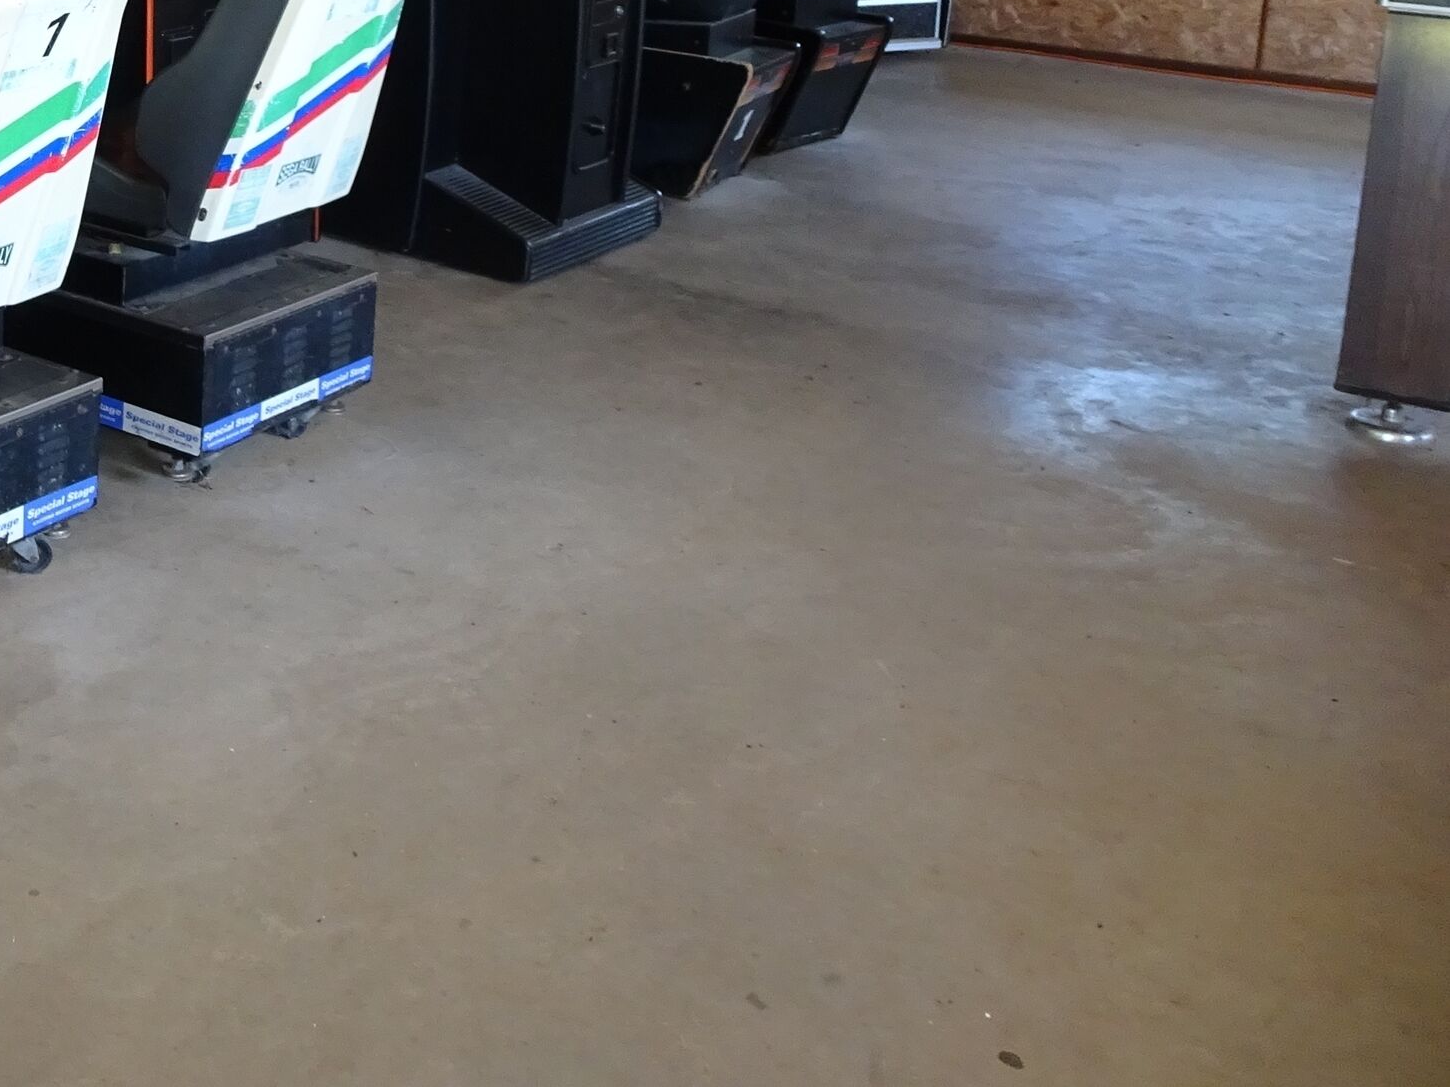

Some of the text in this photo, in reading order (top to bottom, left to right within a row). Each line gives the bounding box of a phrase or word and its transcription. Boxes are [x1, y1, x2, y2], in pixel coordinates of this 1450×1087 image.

[42, 12, 71, 58] 1
[100, 402, 122, 417] tage
[125, 410, 165, 431] Special
[168, 425, 199, 443] Stage
[26, 495, 66, 520] Special
[67, 485, 96, 503] Stage
